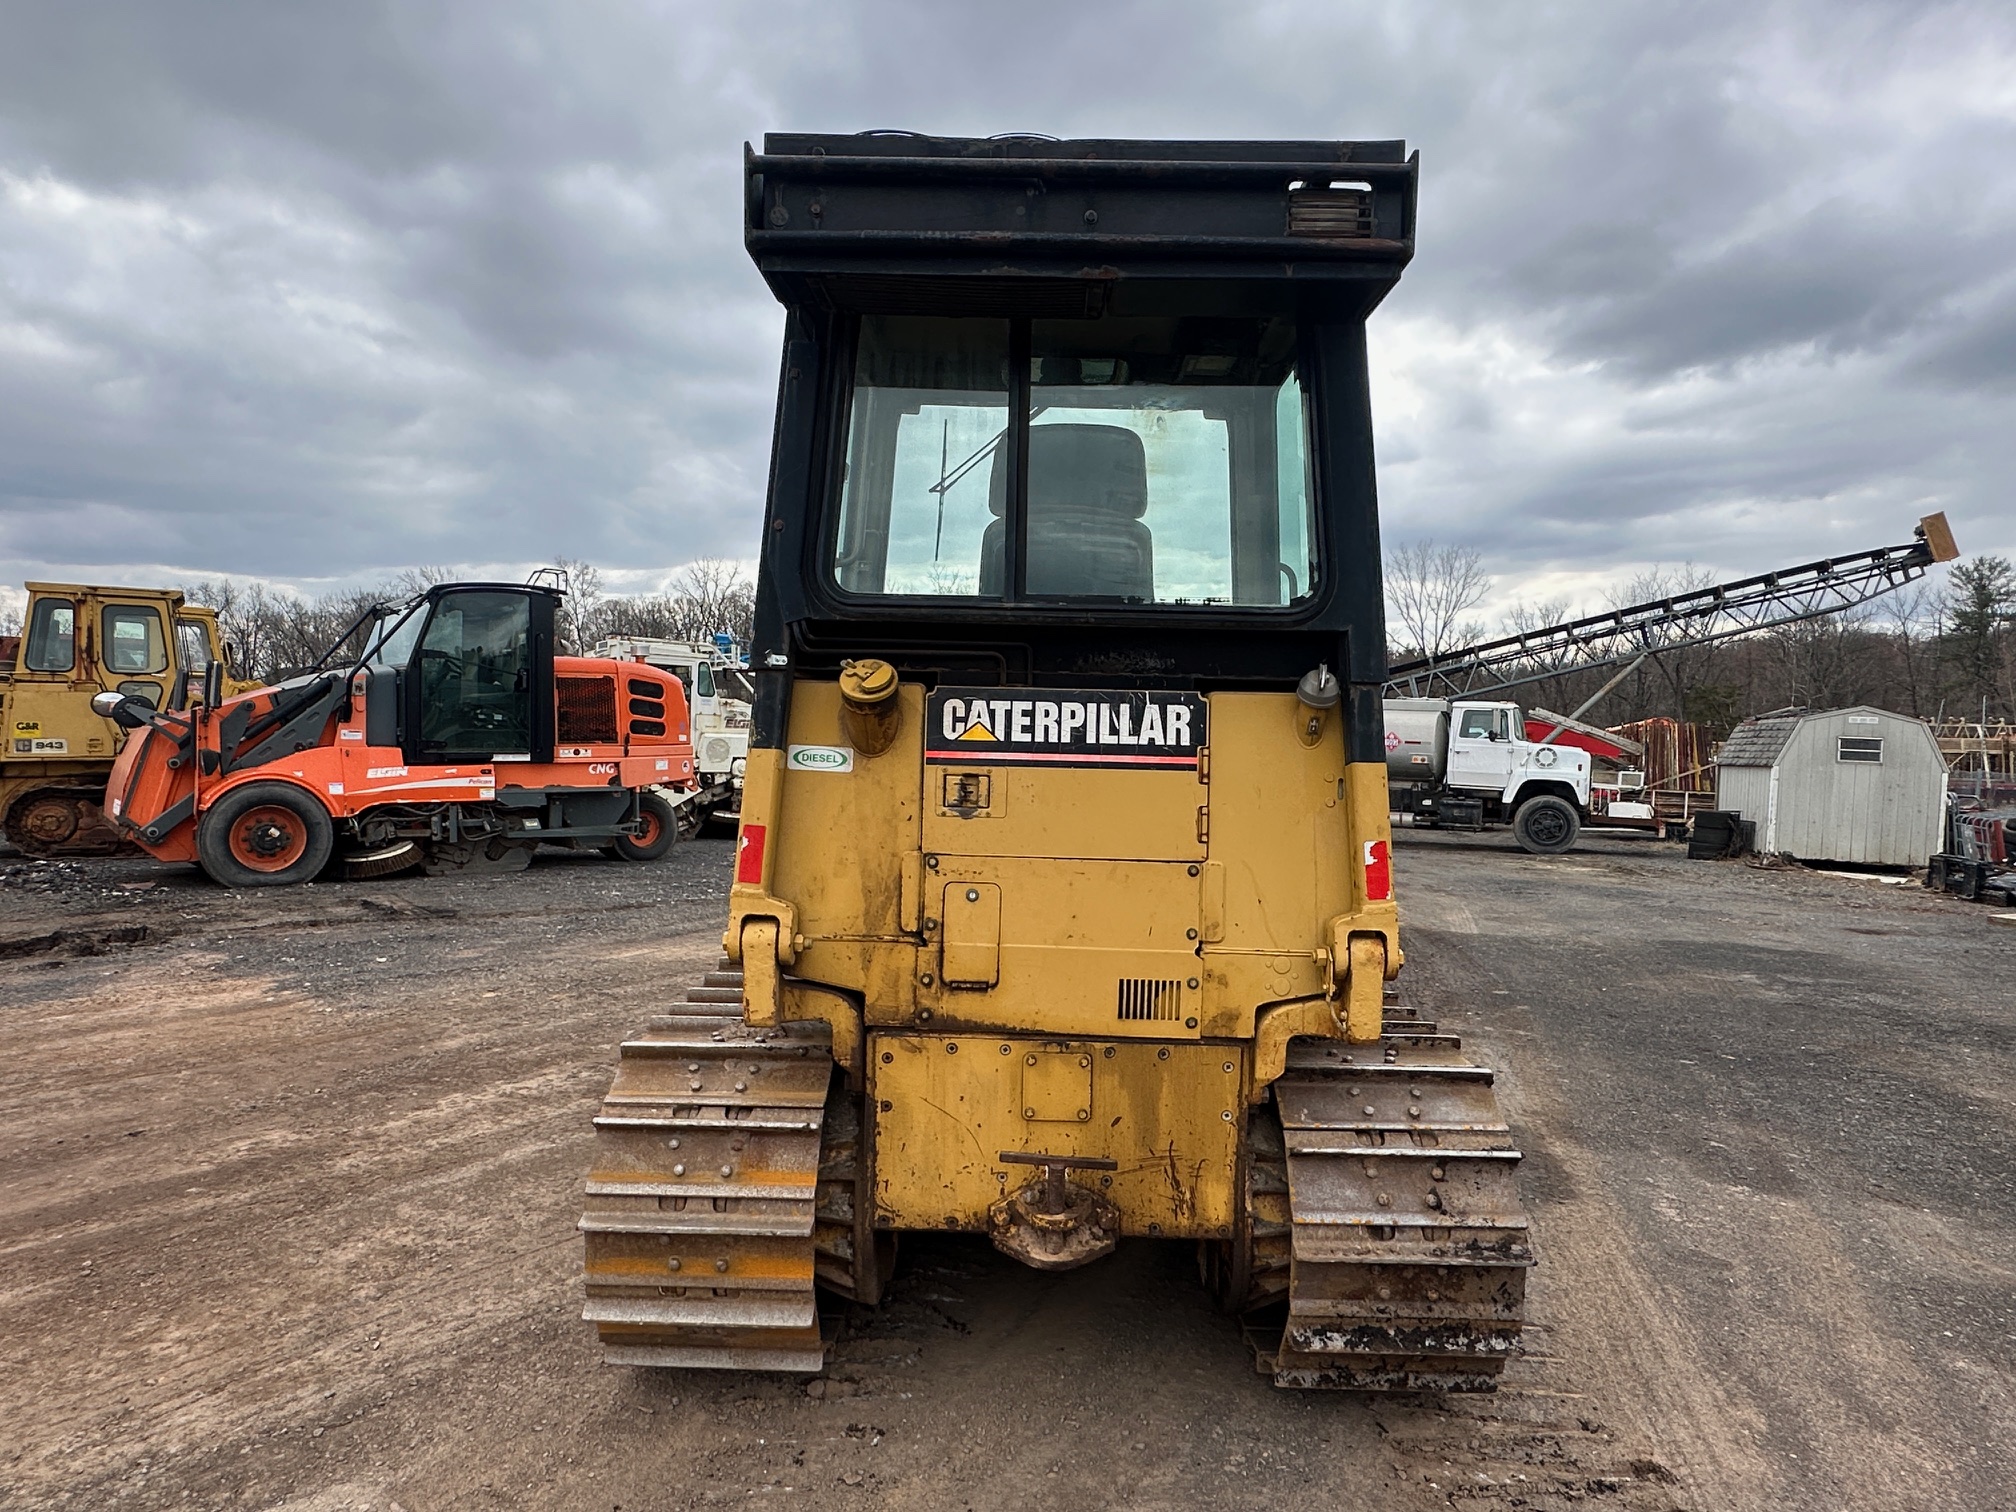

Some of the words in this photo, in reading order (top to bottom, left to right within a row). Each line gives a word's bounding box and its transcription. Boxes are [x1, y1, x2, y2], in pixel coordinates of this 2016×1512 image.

[16, 721, 39, 731] G&R
[725, 718, 751, 729] ELGI
[942, 698, 1191, 746] CATERPILLAR
[35, 741, 64, 749] 943
[801, 753, 839, 763] DIESEL
[366, 766, 408, 779] ELGIN
[588, 763, 615, 774] CNG
